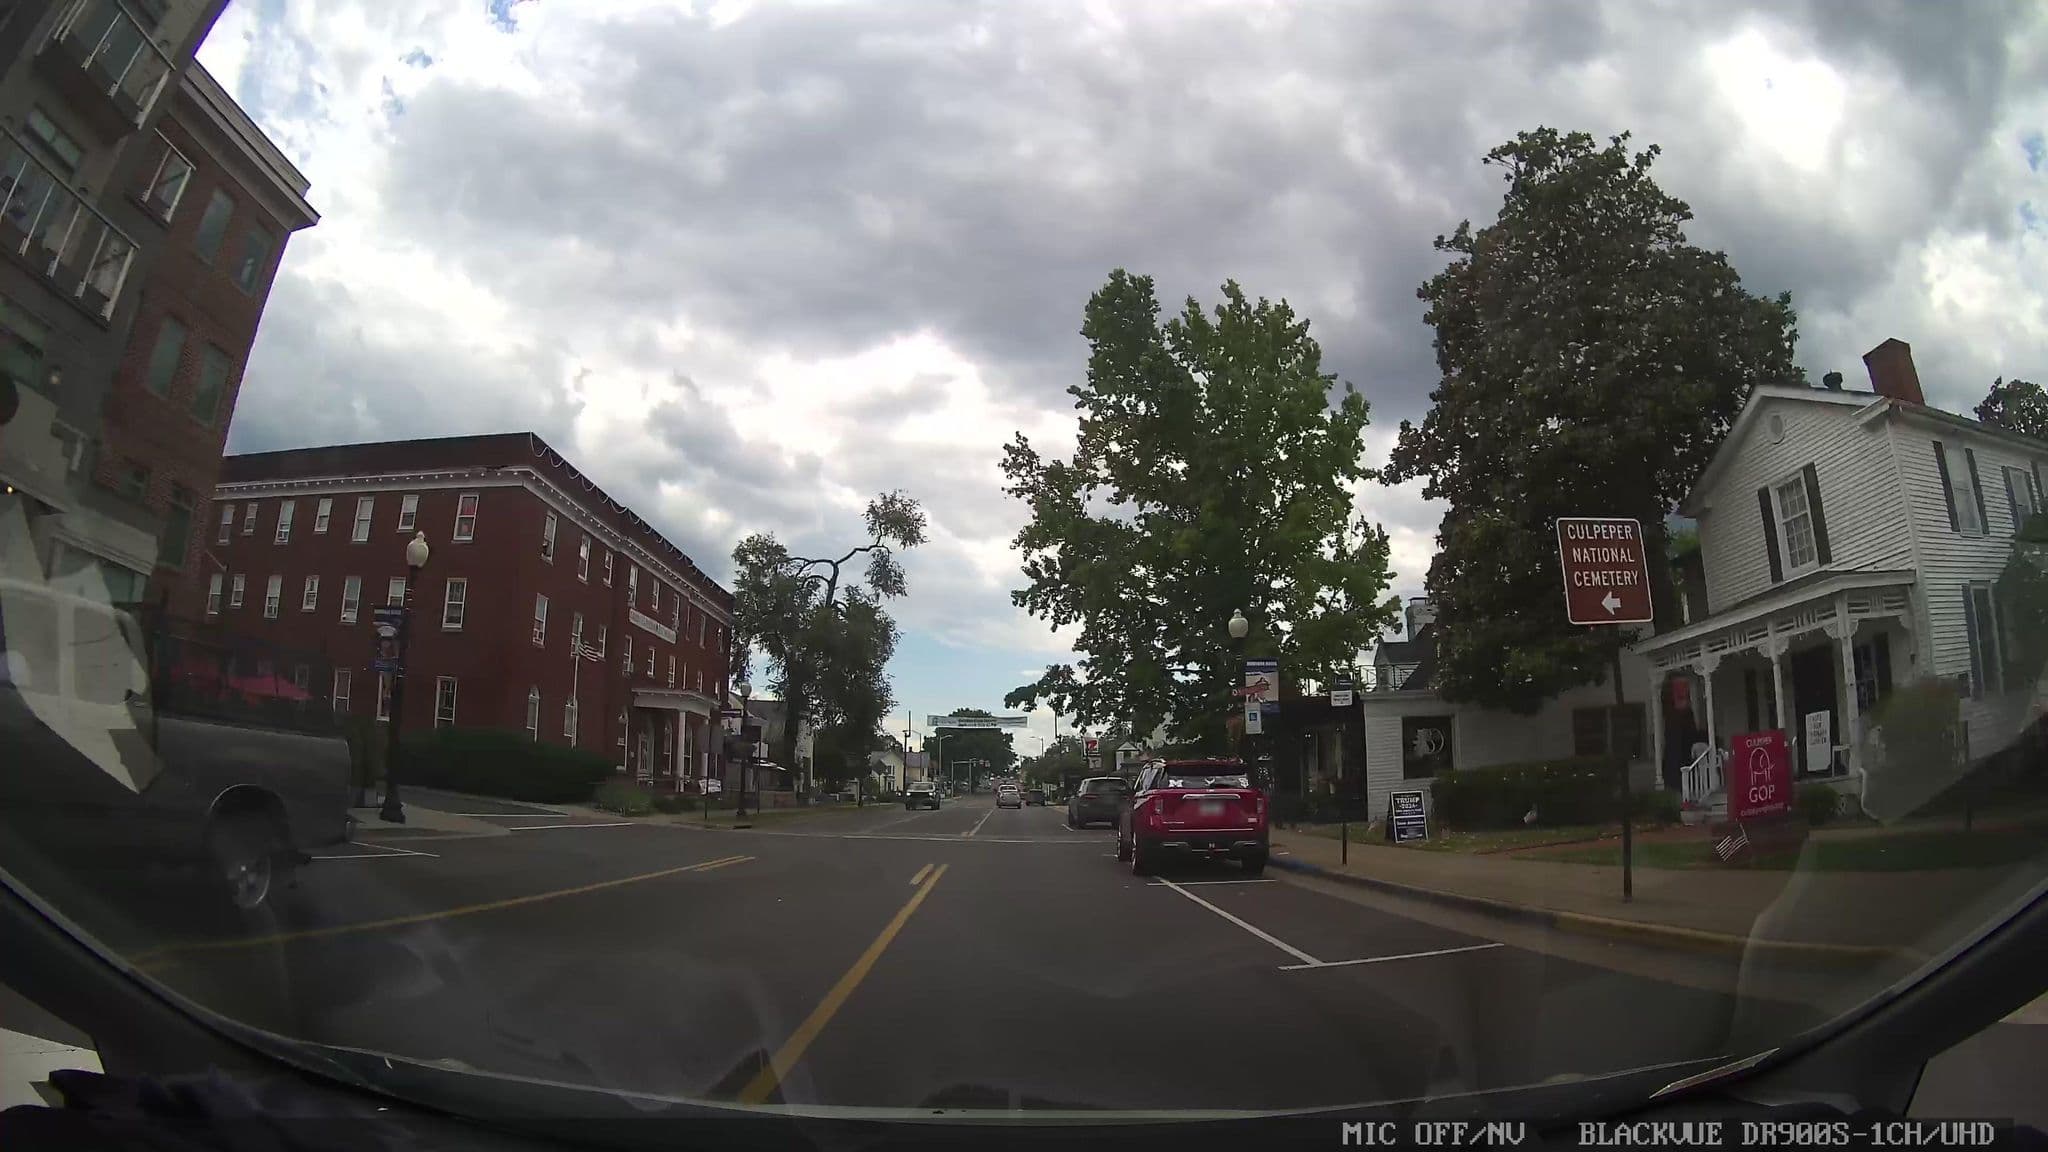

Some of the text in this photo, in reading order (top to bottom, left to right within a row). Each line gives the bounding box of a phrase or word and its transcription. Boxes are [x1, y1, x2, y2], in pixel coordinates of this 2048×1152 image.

[1567, 524, 1633, 540] CULPEPER
[1572, 547, 1635, 563] NATIONAL
[1574, 570, 1638, 587] CEMETERY
[1748, 784, 1775, 803] GOP
